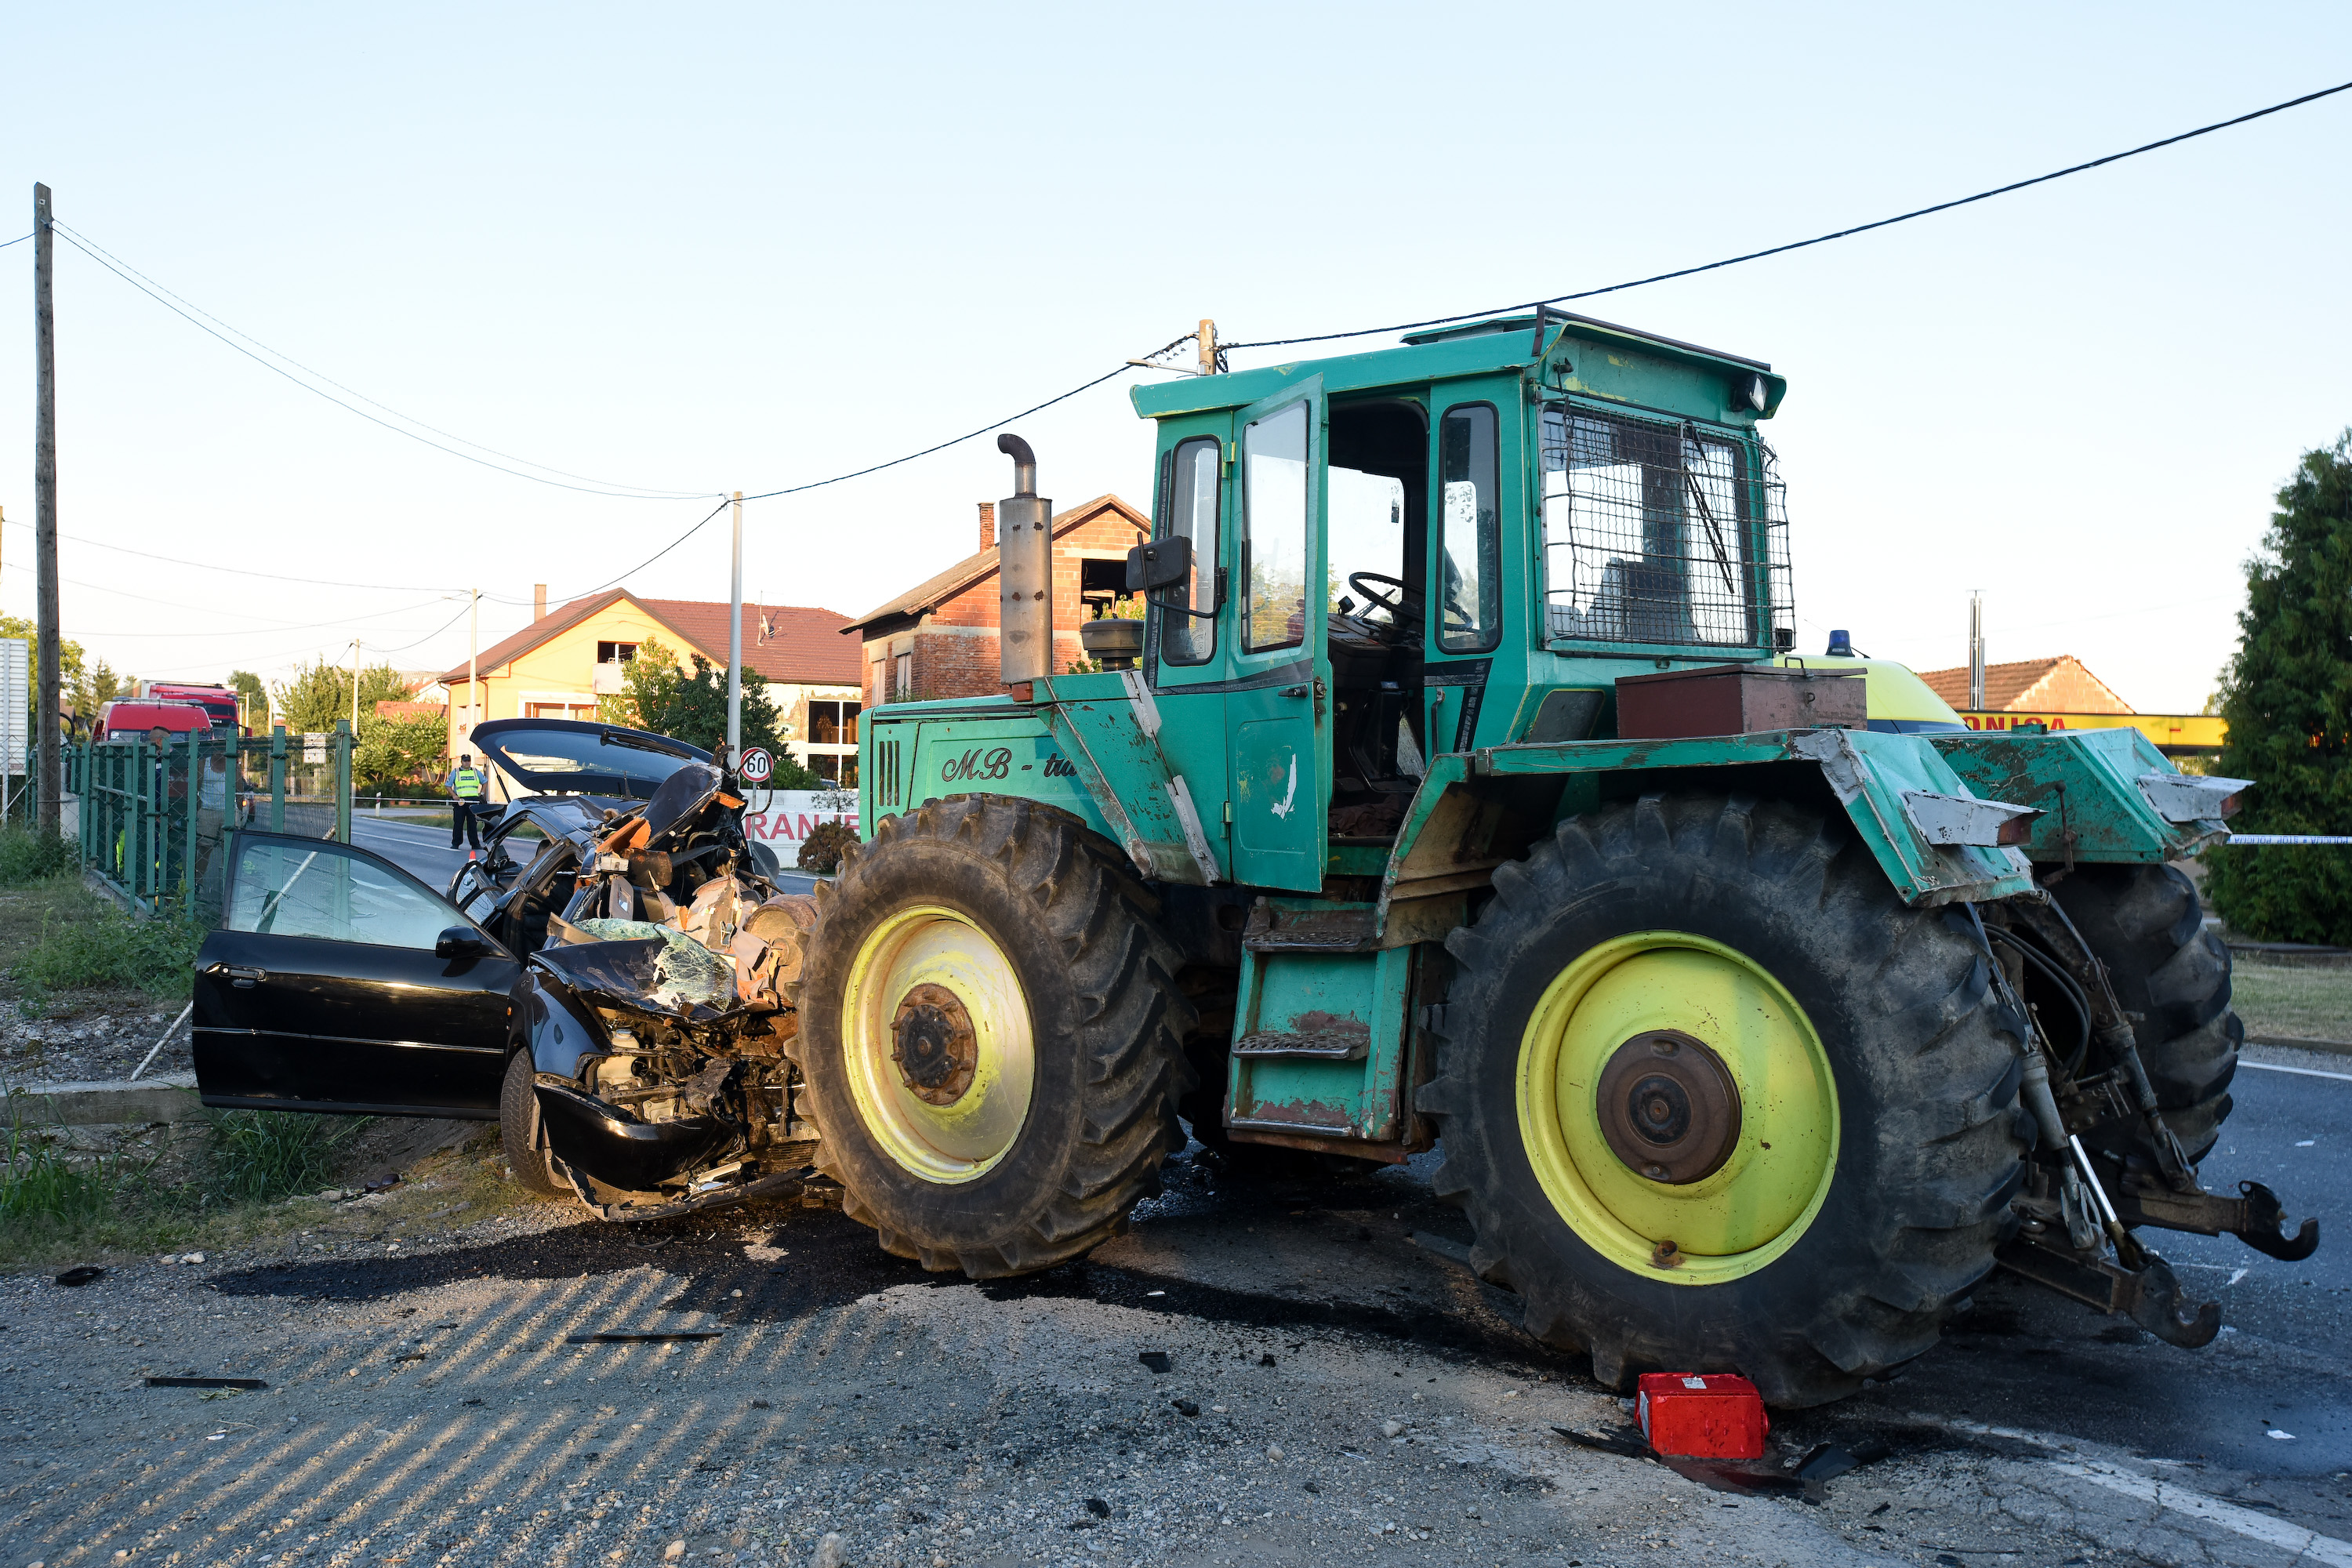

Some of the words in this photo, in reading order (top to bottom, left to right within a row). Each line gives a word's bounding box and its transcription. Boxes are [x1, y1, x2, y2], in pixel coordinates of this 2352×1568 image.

[747, 757, 766, 774] 60
[942, 747, 1012, 782] MB
[2234, 835, 2272, 844] POLICIJA
[2277, 835, 2299, 844] STOP
